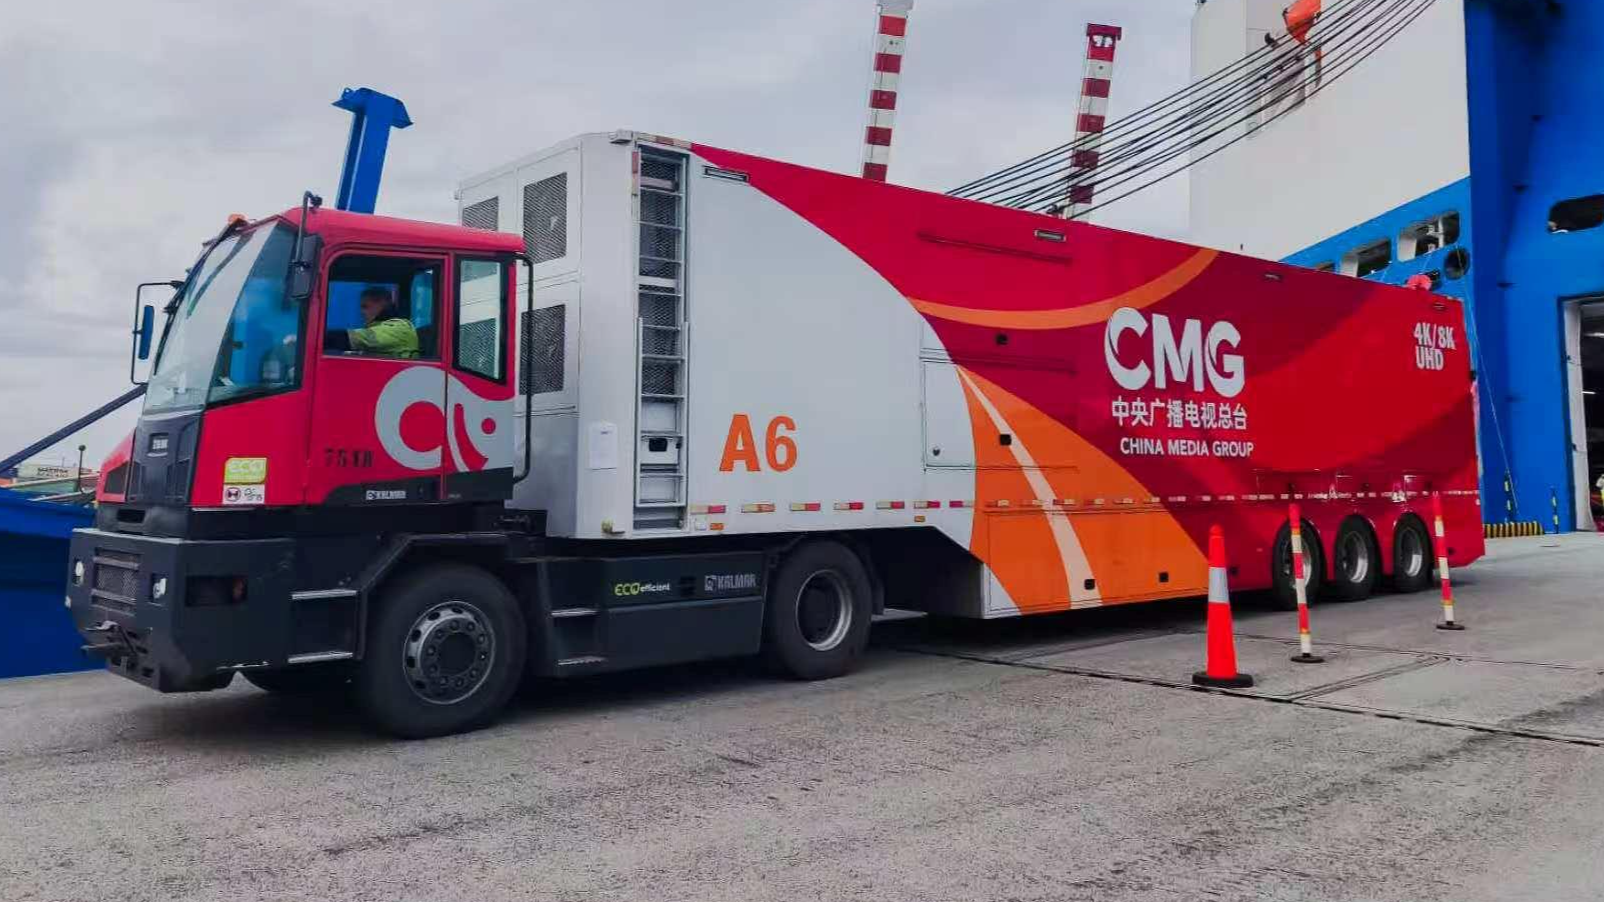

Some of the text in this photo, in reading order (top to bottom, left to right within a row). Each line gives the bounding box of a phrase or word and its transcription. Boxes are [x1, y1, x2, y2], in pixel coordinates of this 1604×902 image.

[1413, 322, 1456, 350] 4K/8K
[1104, 306, 1246, 398] CMG
[1415, 345, 1444, 370] UHD
[1111, 395, 1248, 430] 中央广播电视总台
[719, 413, 798, 473] A6
[1120, 437, 1254, 458] CHINA MEDIA GROUP
